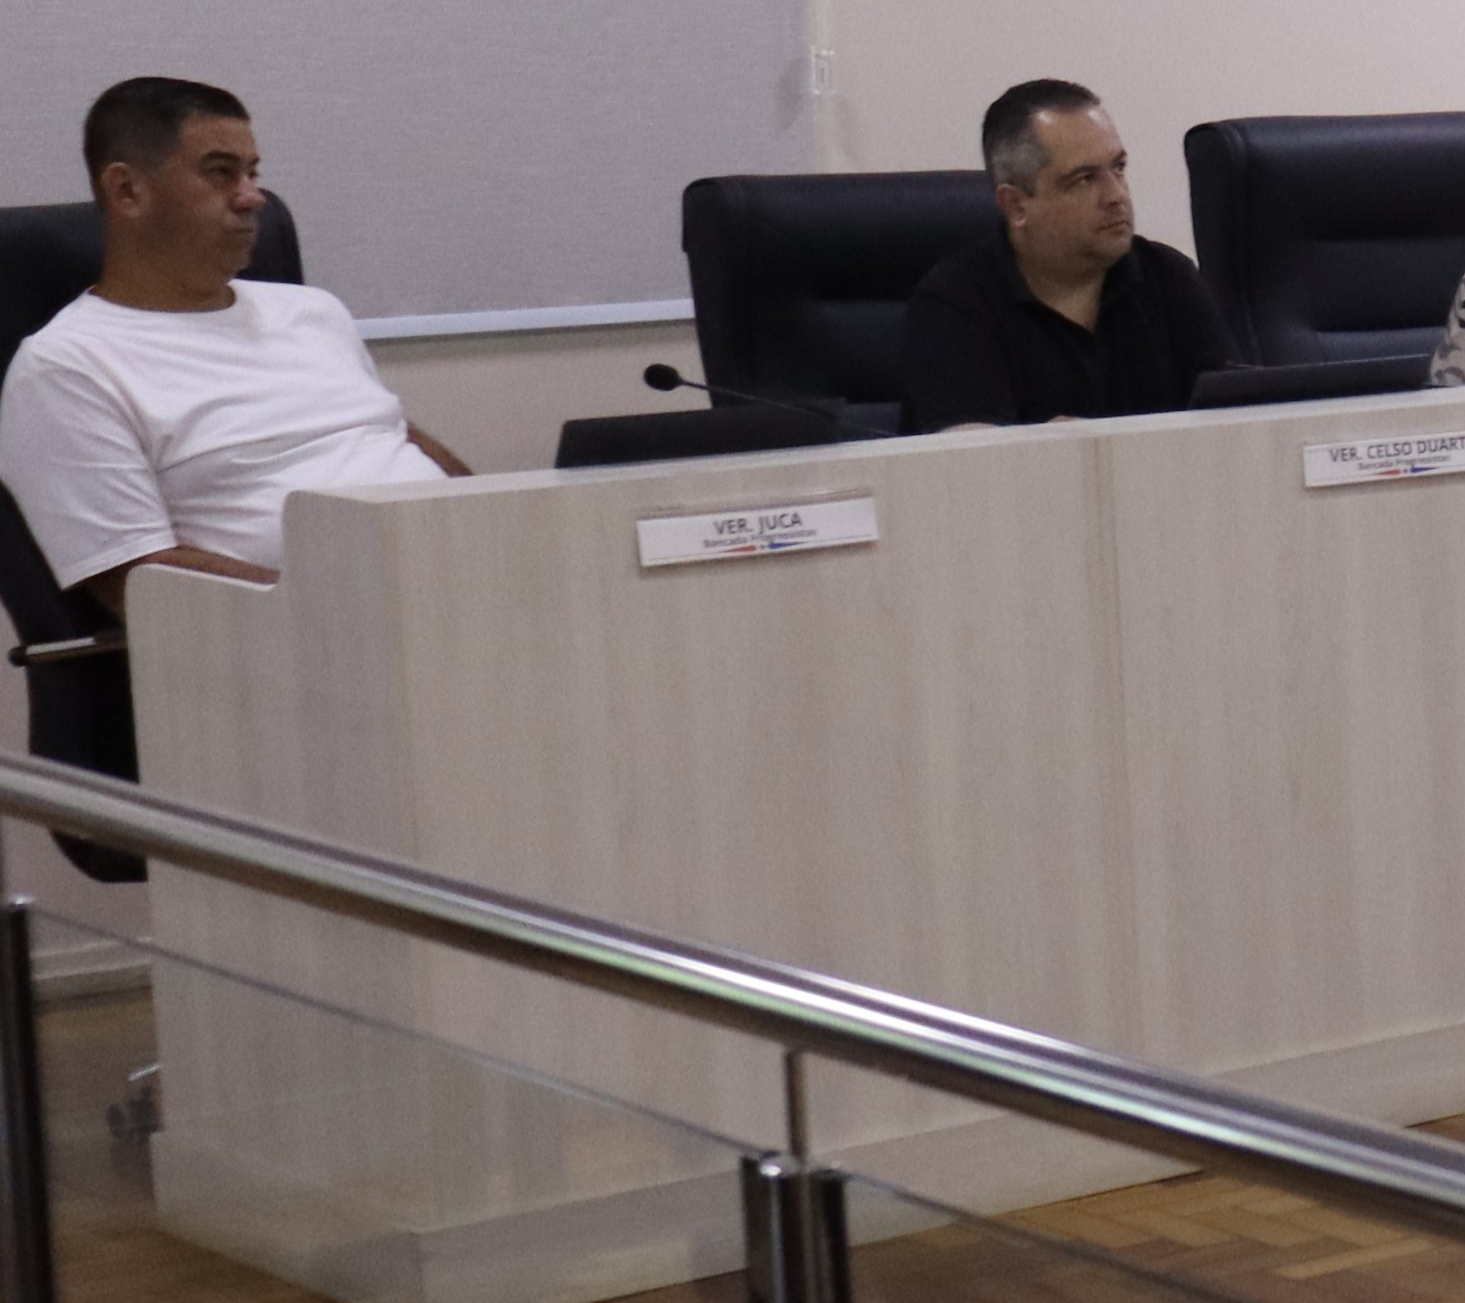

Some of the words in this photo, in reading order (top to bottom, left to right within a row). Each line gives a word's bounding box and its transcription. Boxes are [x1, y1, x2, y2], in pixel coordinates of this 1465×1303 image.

[1329, 448, 1362, 463] VER.
[1367, 442, 1412, 459] CELSO
[713, 518, 753, 535] VER.
[757, 512, 803, 534] JUCA
